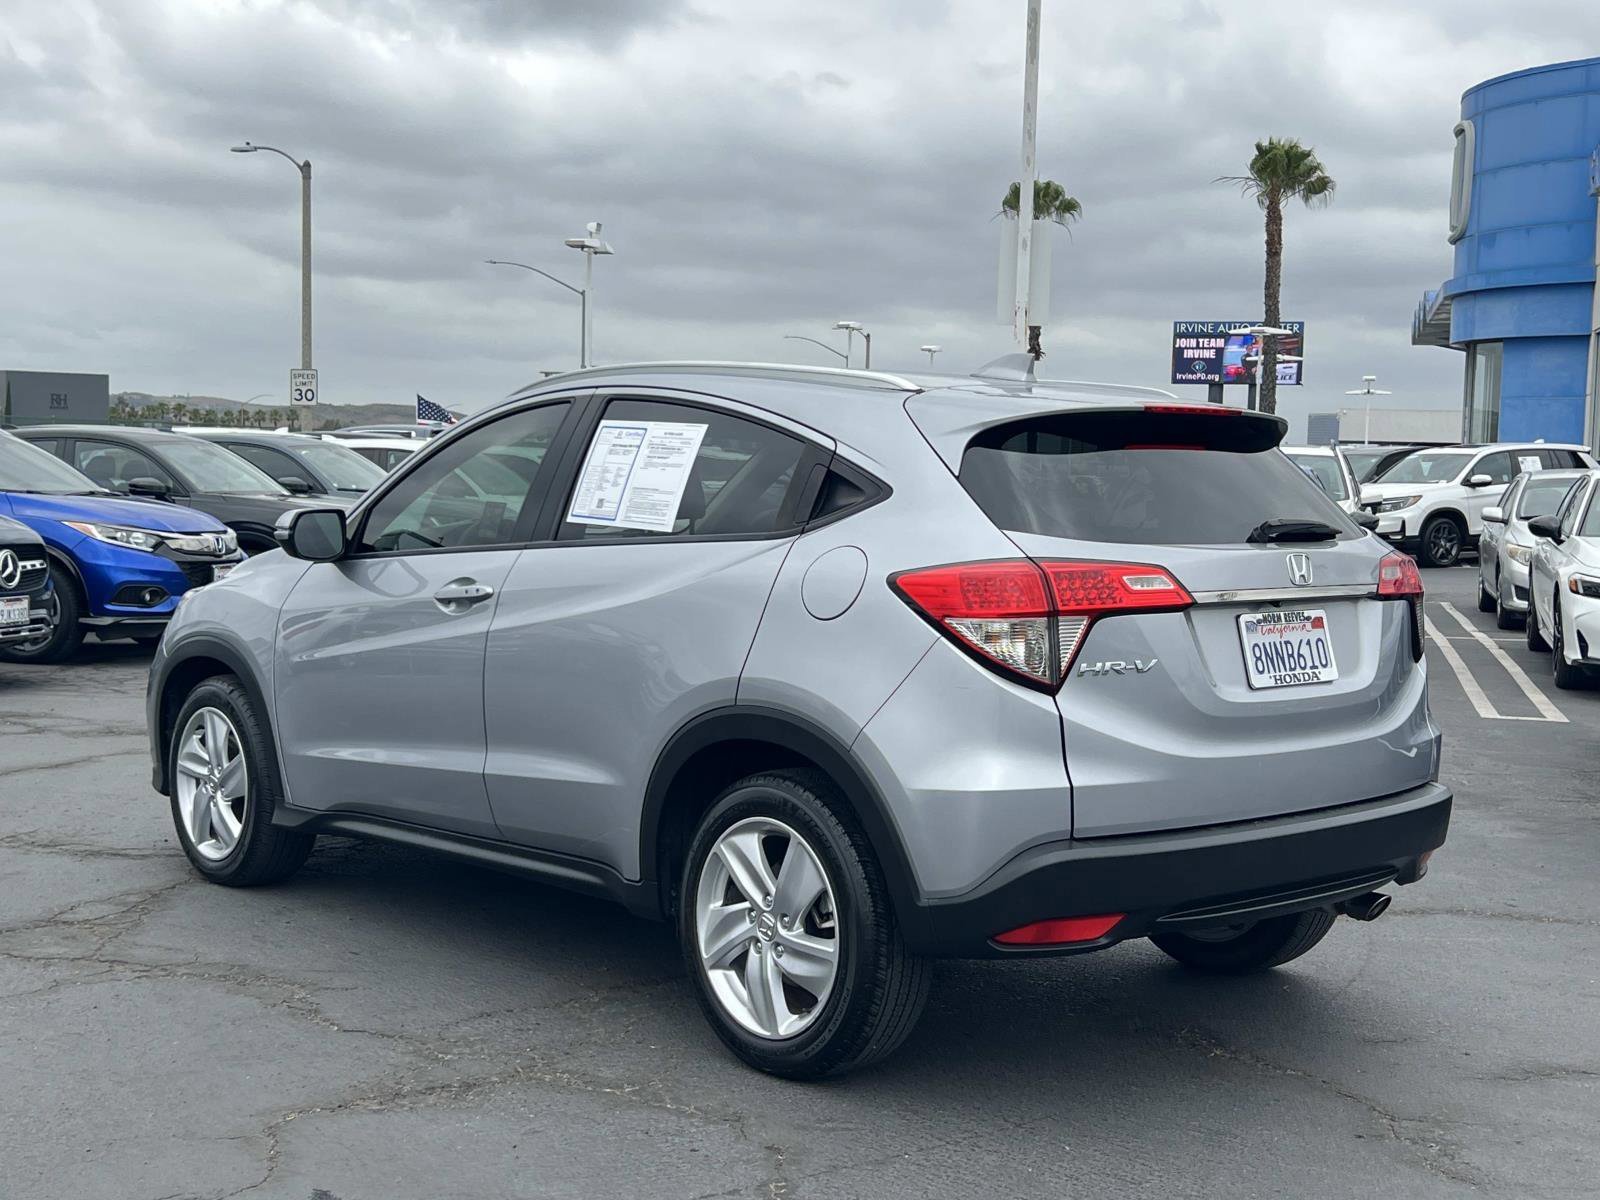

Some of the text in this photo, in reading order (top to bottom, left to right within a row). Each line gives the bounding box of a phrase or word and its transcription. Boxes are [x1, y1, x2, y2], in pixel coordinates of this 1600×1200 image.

[1176, 322, 1214, 333] IRVINE
[1175, 338, 1225, 348] JOIN TEAM
[1183, 349, 1217, 359] IRVINE
[1176, 372, 1220, 382] IrvinePD.org
[294, 388, 315, 402] 30
[1262, 611, 1306, 624] NORM REEVES
[1260, 623, 1311, 639] California
[1252, 637, 1329, 675] 8NNB610
[1077, 658, 1159, 677] HR-V
